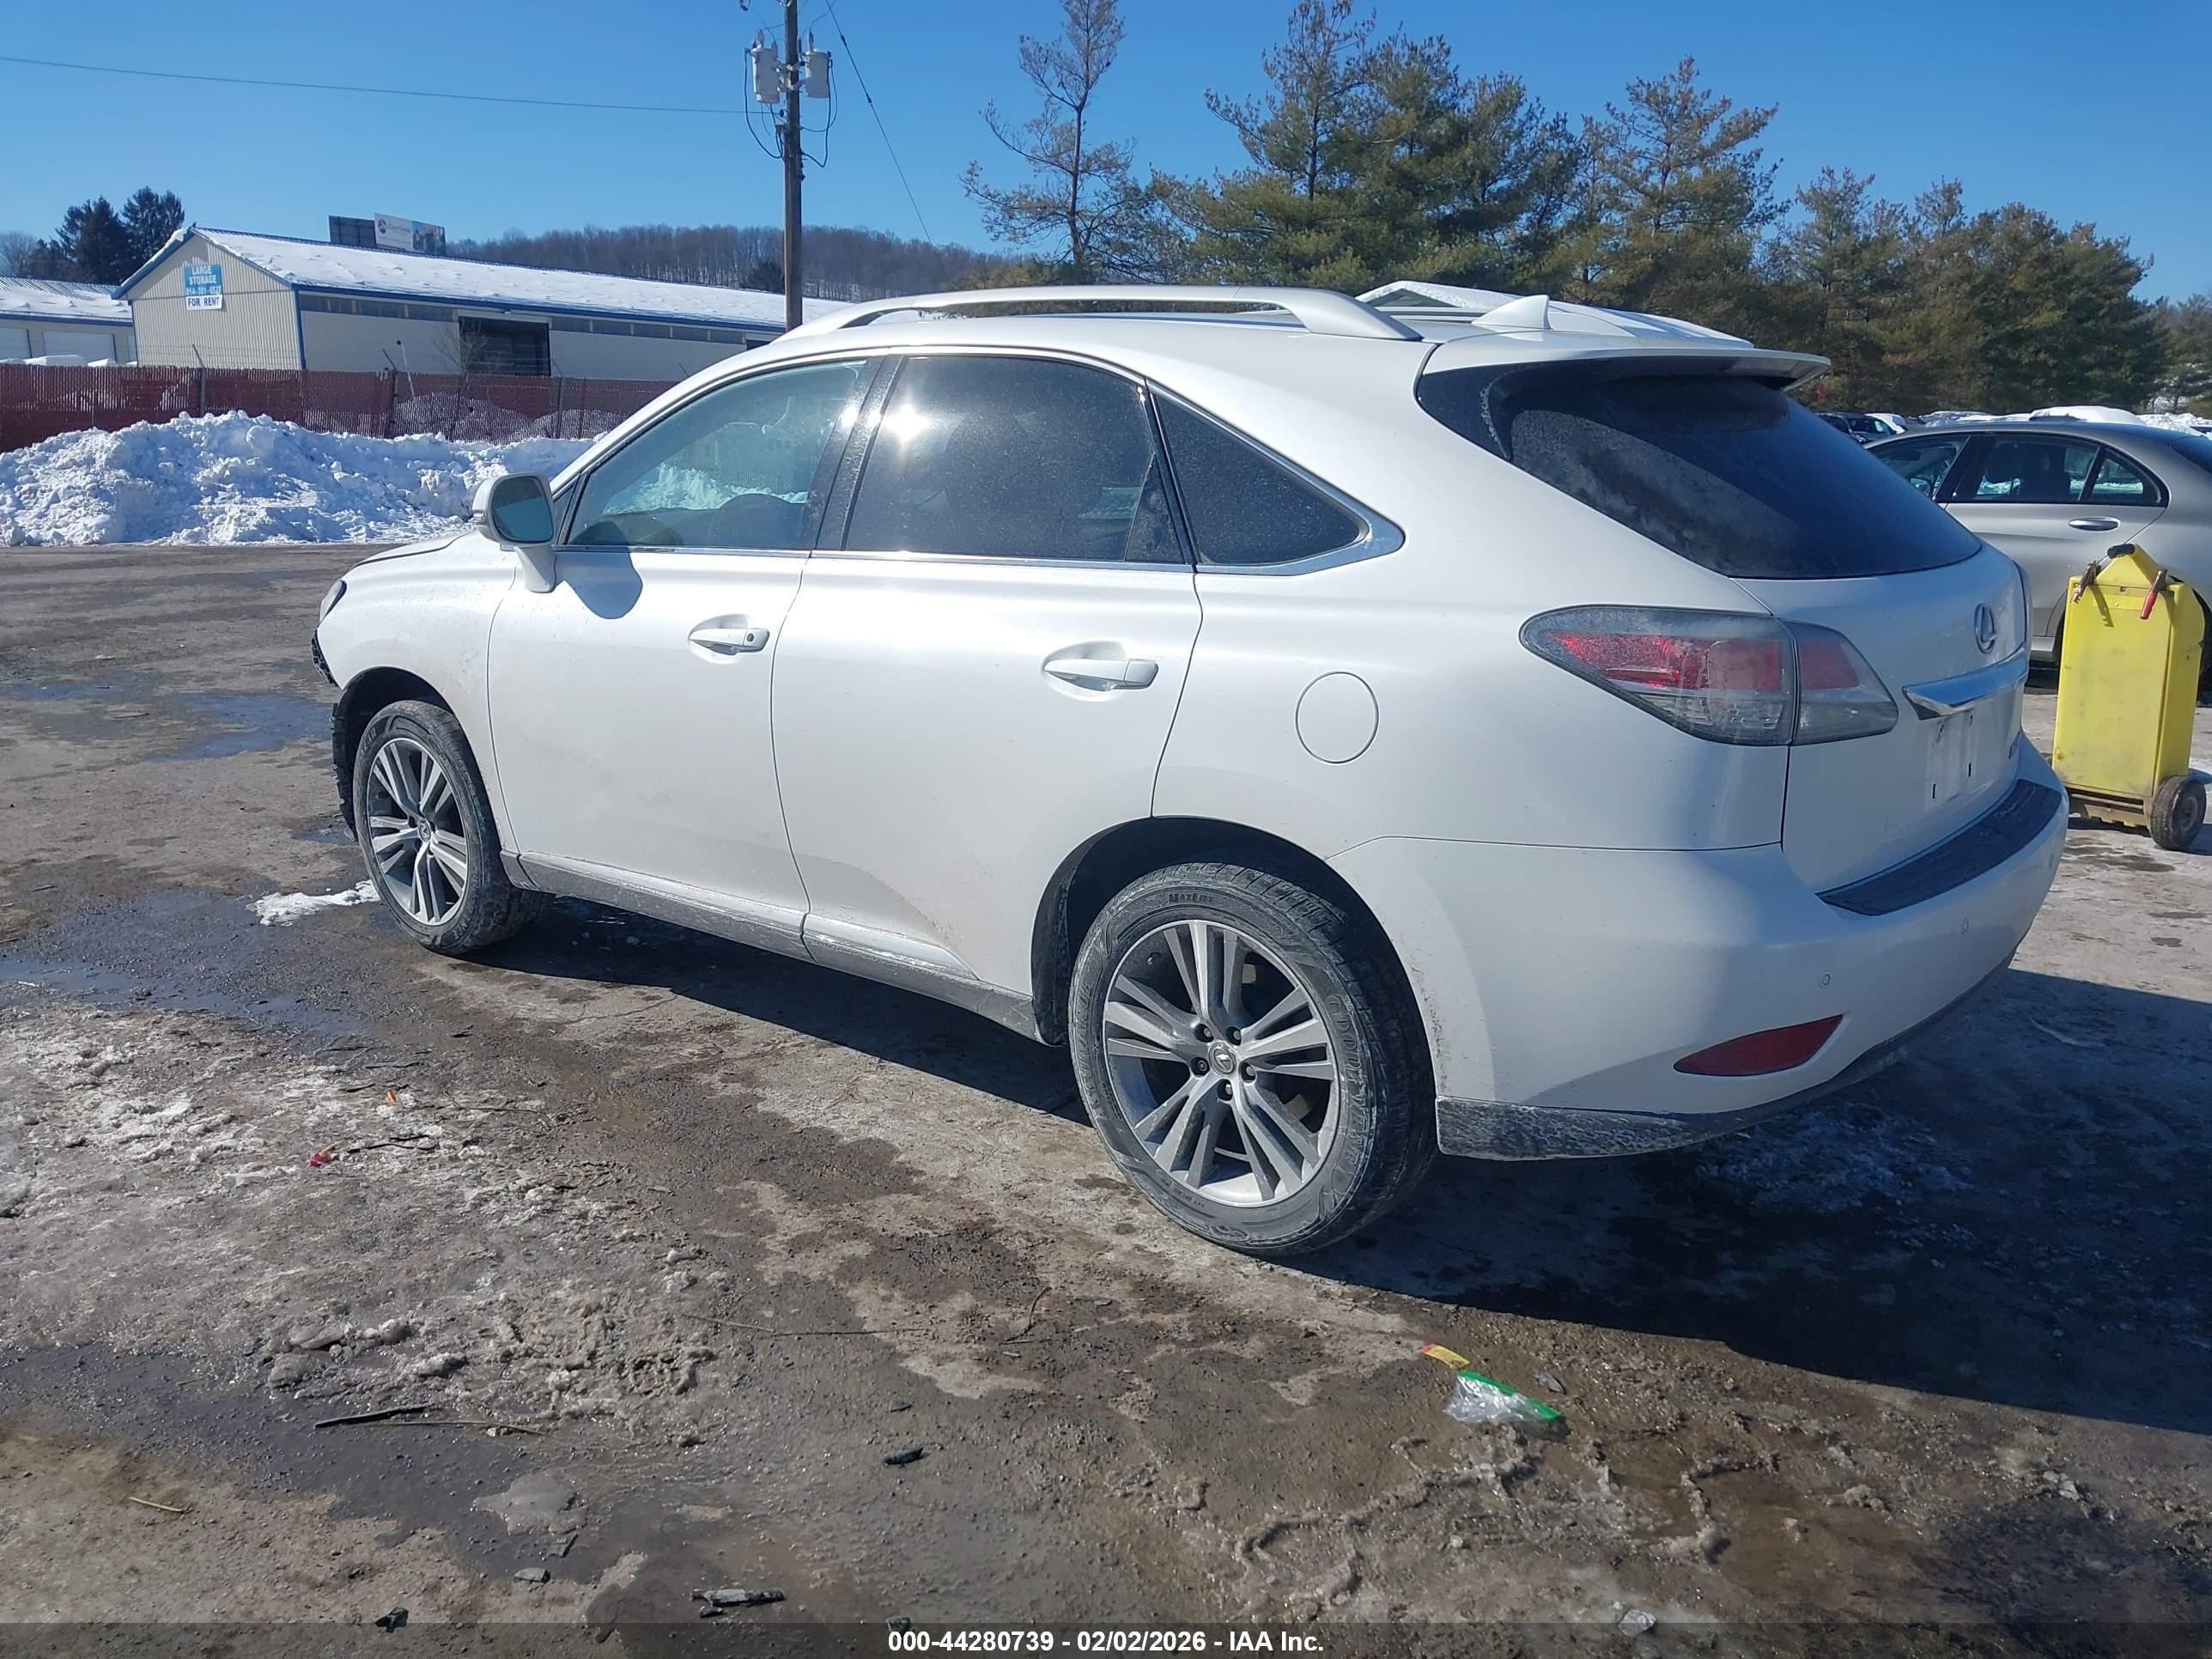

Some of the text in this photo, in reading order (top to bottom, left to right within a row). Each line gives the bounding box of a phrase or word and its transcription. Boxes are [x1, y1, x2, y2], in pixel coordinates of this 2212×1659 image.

[191, 265, 211, 275] LARGE
[189, 275, 216, 285] STORAGE
[187, 297, 220, 307] FOR RENT
